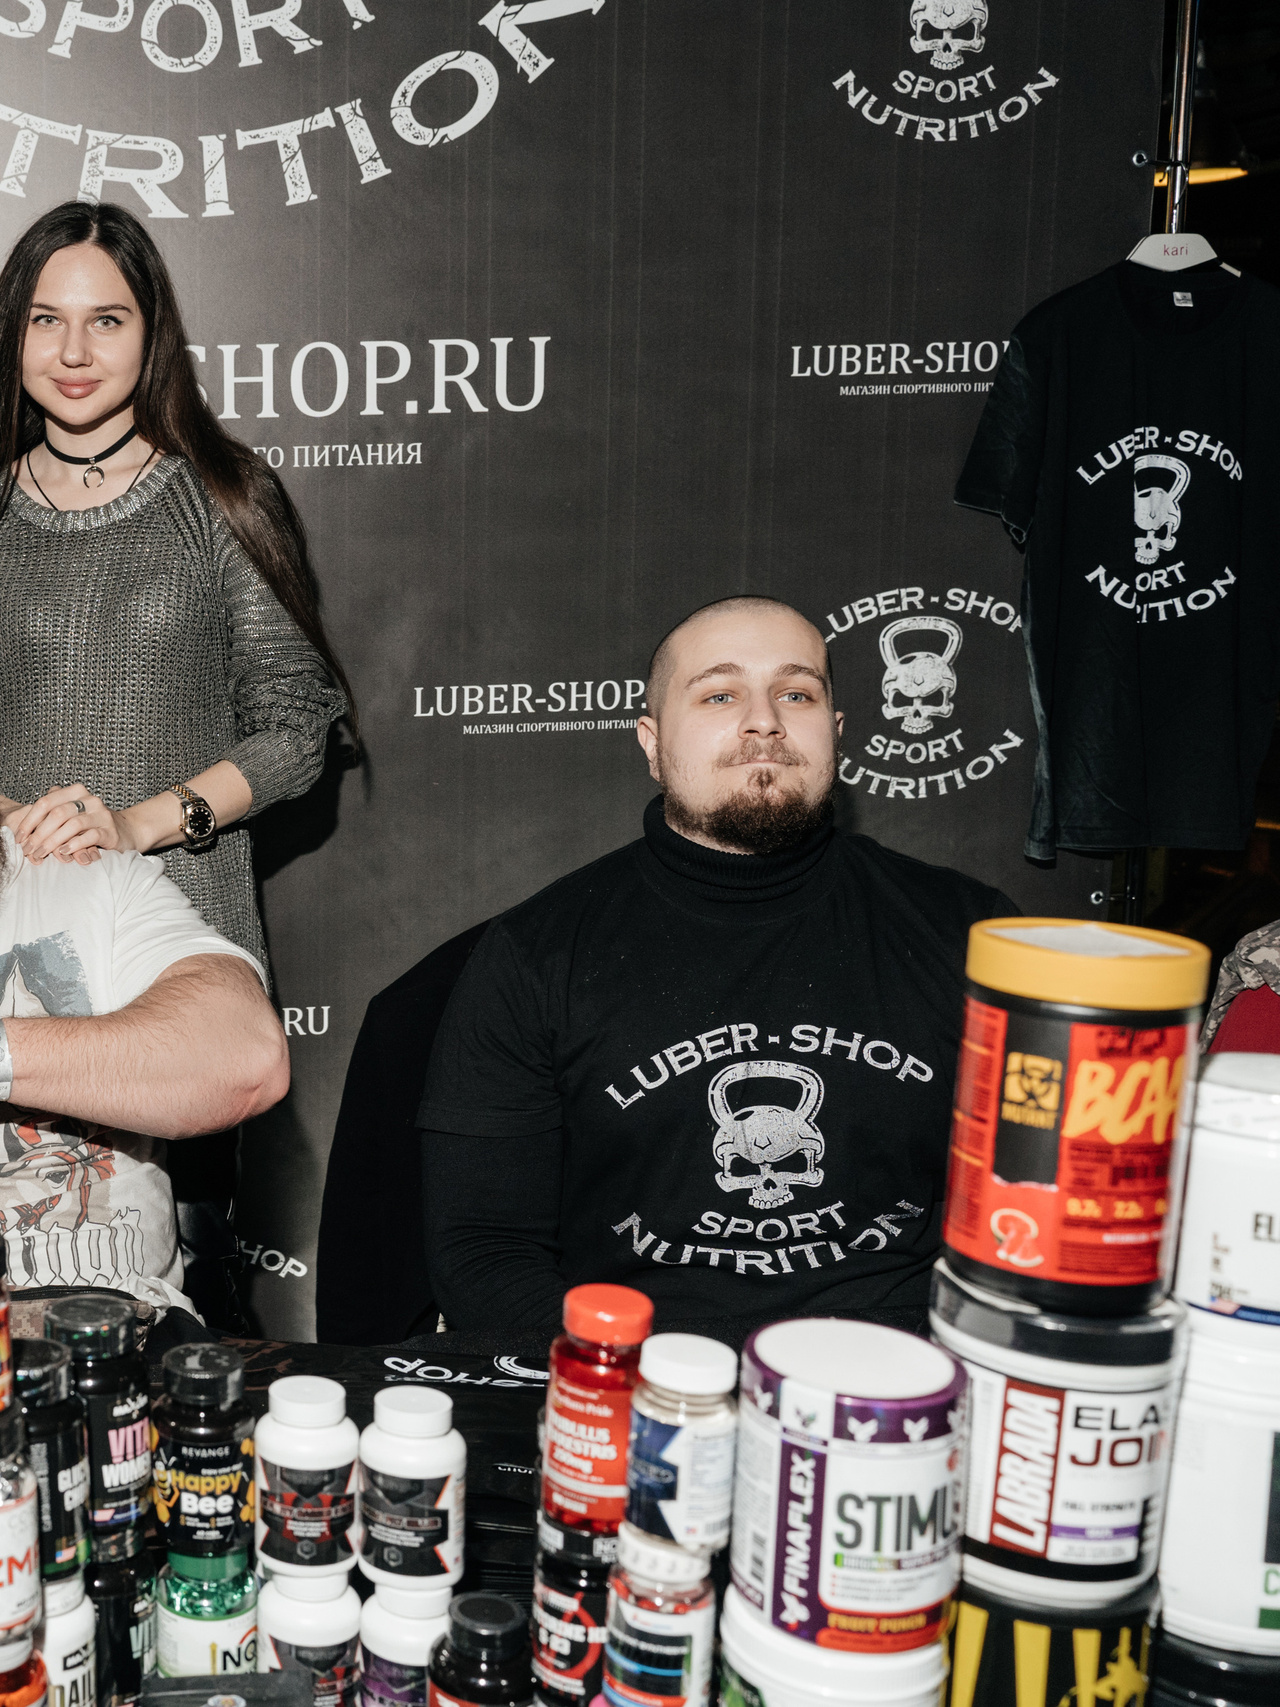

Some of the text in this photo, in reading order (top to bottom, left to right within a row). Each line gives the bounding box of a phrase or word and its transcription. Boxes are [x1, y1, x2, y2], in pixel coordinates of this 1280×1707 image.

[892, 65, 997, 103] SPORT
[832, 66, 1061, 142] NUTRITION
[1163, 243, 1189, 257] kari
[839, 385, 891, 396] МАГАЗИН
[893, 382, 972, 395] СПОРТИВНОГО
[292, 442, 423, 468] ПИТАНИЯ
[1076, 426, 1160, 485] LUBER
[1175, 430, 1243, 481] SHOP
[462, 723, 515, 735] МАГАЗИН
[516, 720, 596, 734] СПОРТИВНОГО
[864, 728, 965, 764] SPORT
[605, 1022, 759, 1109] LUBER
[789, 1024, 934, 1085] SHOP
[612, 1199, 924, 1276] NUTRITION
[692, 1201, 846, 1242] SPORT
[182, 1445, 230, 1458] REVANGE
[171, 1468, 242, 1496] Happy
[993, 1387, 1061, 1554] LABRADA
[180, 1491, 234, 1516] Bee
[783, 1452, 817, 1598] FINAFLEX
